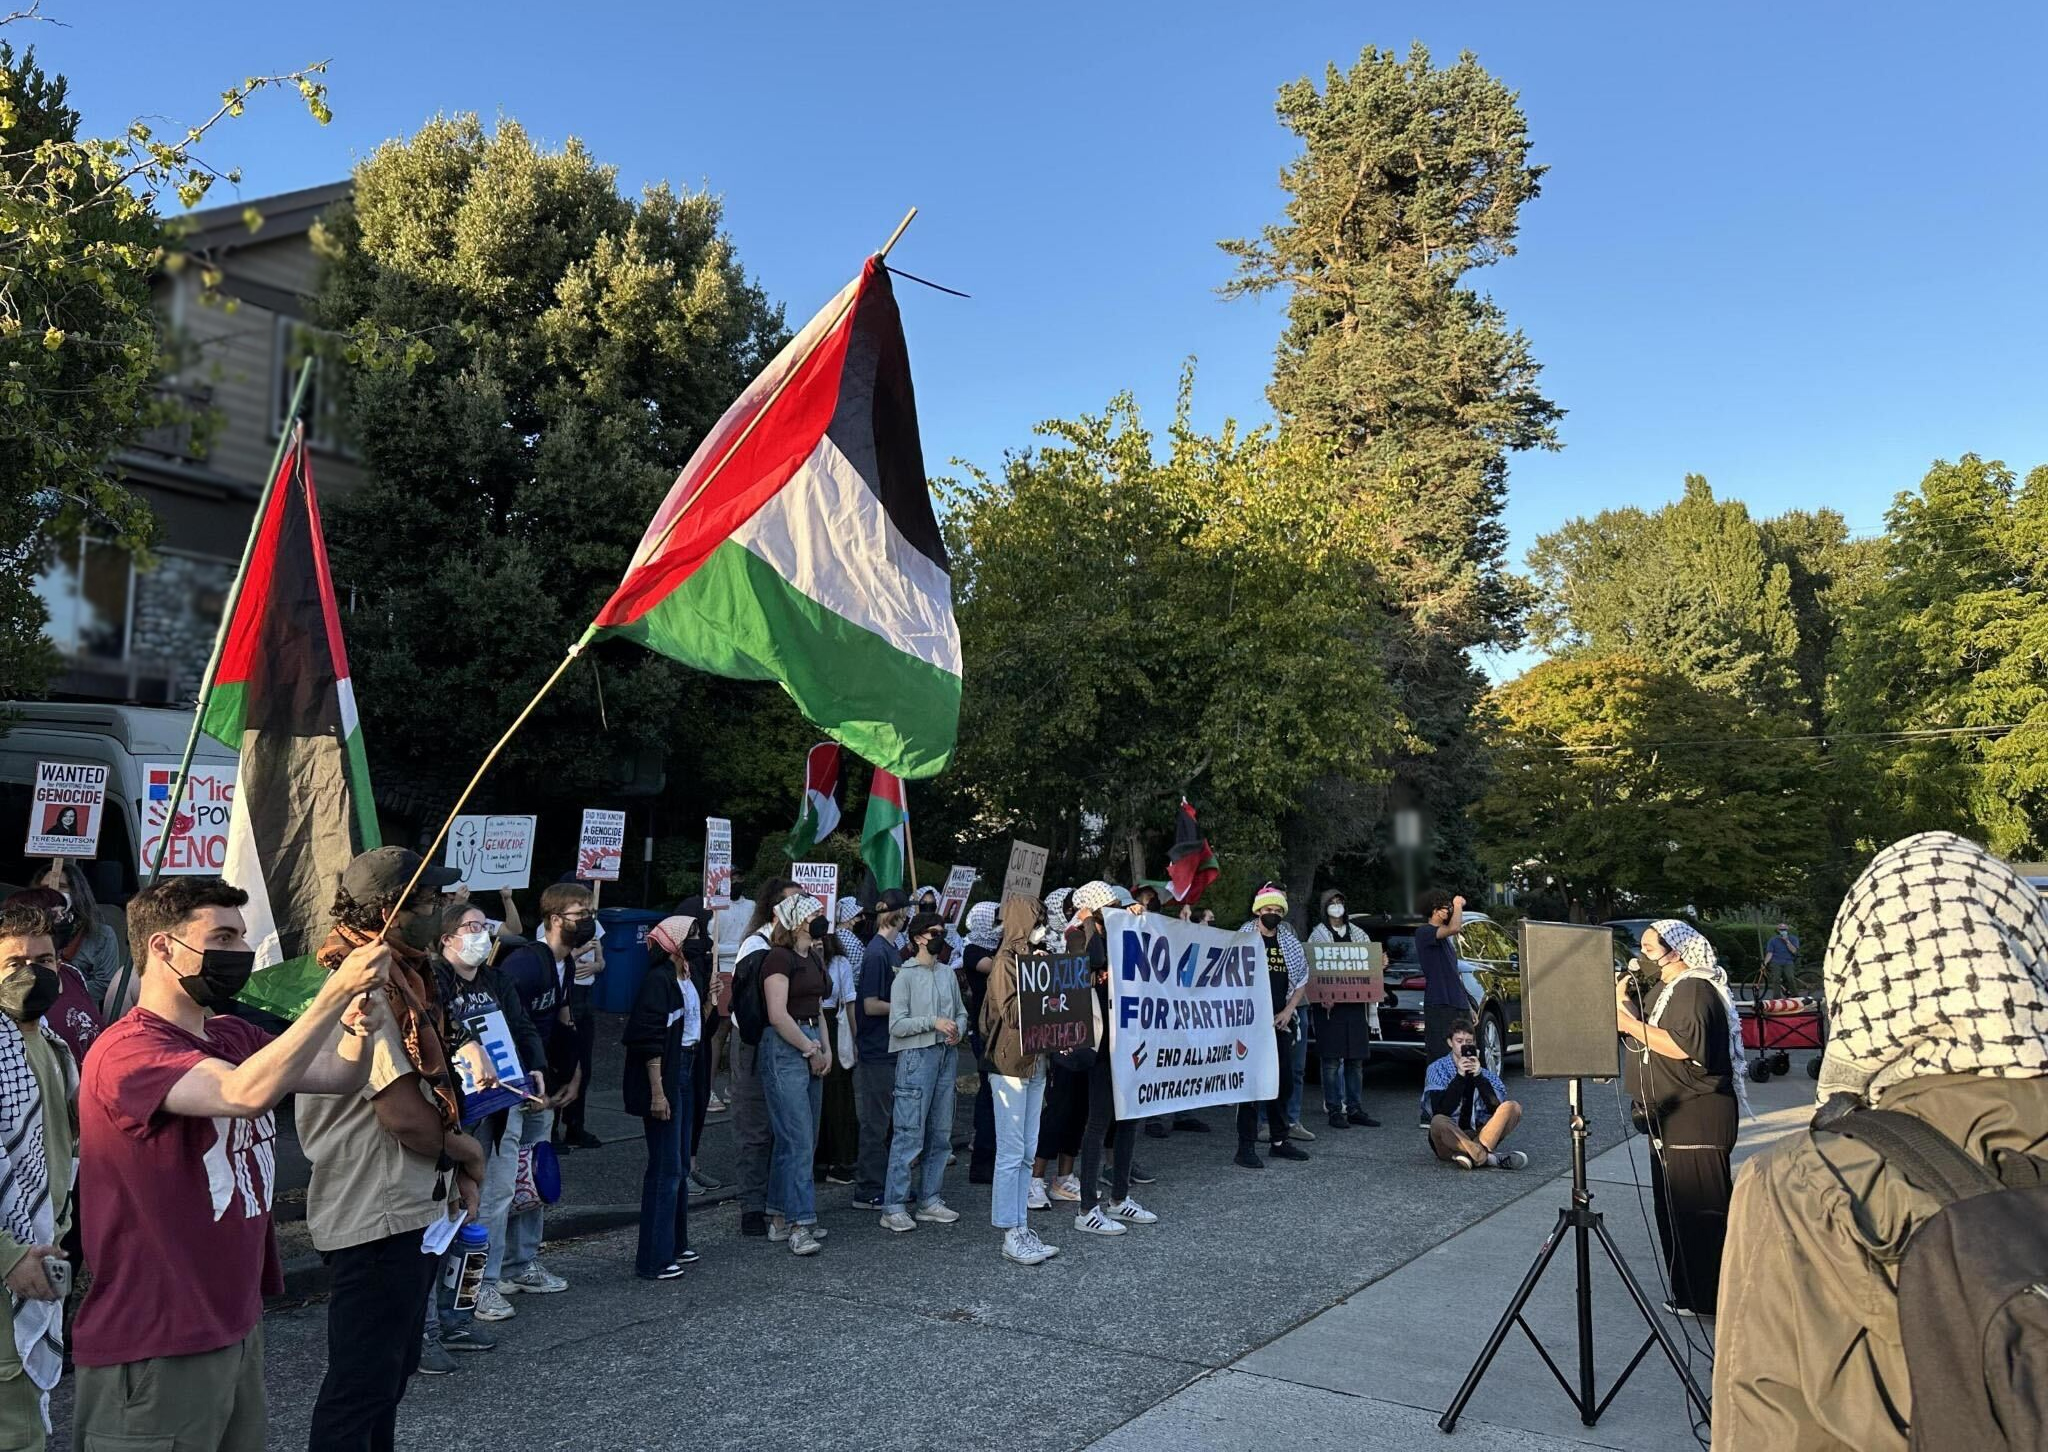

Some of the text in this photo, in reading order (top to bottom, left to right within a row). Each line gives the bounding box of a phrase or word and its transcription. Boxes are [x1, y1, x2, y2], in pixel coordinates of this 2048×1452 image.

[42, 765, 105, 783] WANTED
[37, 788, 102, 804] GENOCIDE
[198, 806, 231, 826] PO
[597, 812, 607, 820] YOU
[584, 826, 622, 836] A GENOCIDE
[485, 839, 526, 850] GENOCIDE
[1010, 847, 1028, 870] CUT
[795, 865, 836, 878] WANTED
[952, 868, 975, 882] WANTED
[1122, 930, 1256, 988] NO AZURE
[1314, 946, 1369, 960] DEFUND
[1021, 956, 1091, 993] NO AZURE
[1316, 961, 1369, 971] GENOCIDE
[1318, 977, 1371, 985] FREE PALESTINE
[1041, 993, 1070, 1015] FOR
[1120, 996, 1255, 1030] FOR APARTHEID
[1023, 1020, 1088, 1053] APARTHEID
[1156, 1044, 1233, 1068] END ALL AZURE
[1138, 1072, 1244, 1105] CONTRACTS WITH IOF
